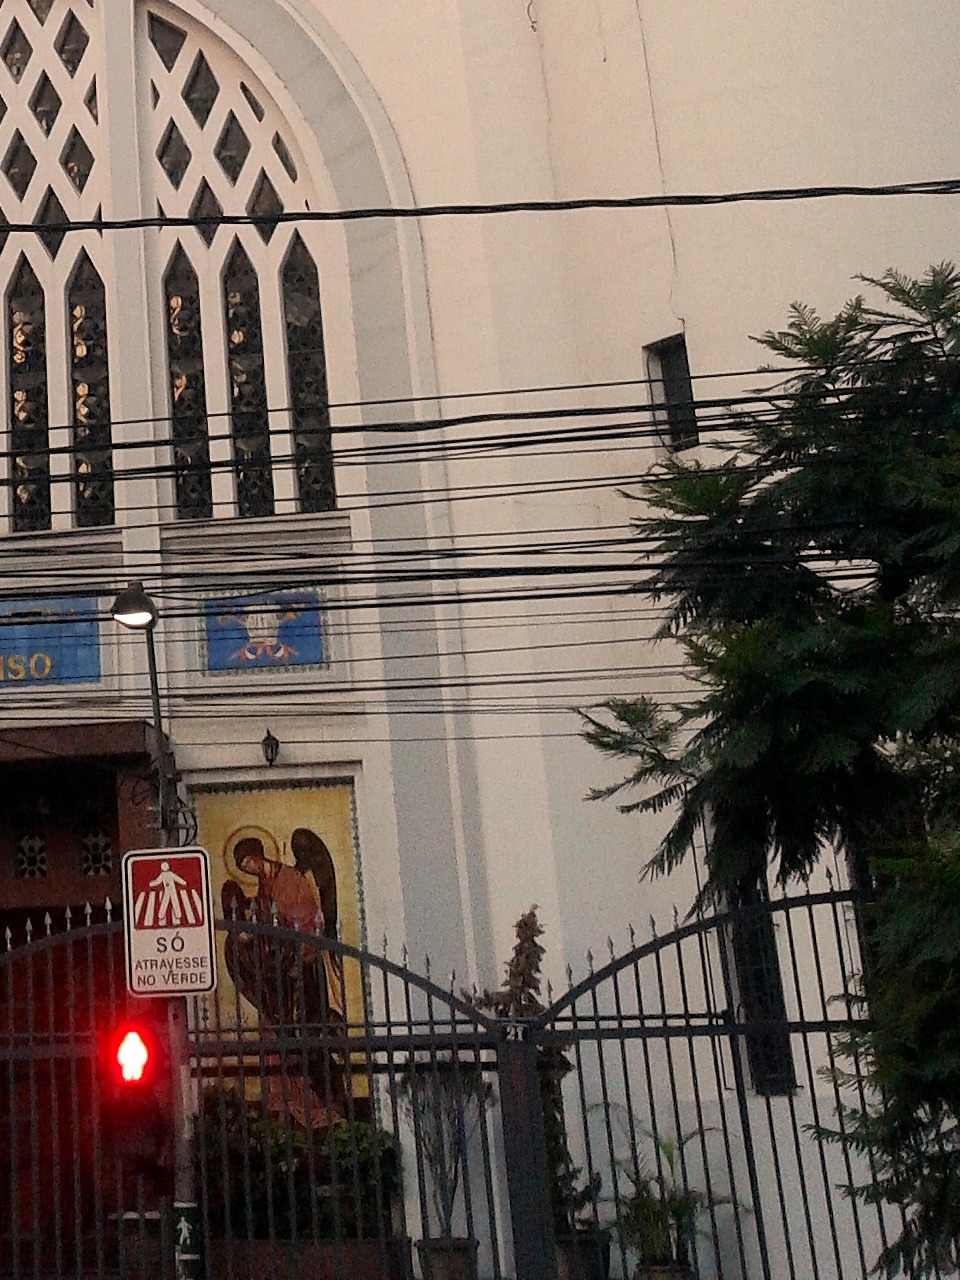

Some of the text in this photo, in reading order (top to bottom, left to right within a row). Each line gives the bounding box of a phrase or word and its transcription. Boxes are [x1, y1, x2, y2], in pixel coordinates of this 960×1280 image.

[156, 931, 185, 953] SÓ
[135, 956, 208, 970] ATRAVESSE
[137, 970, 207, 986] NO VERDE
